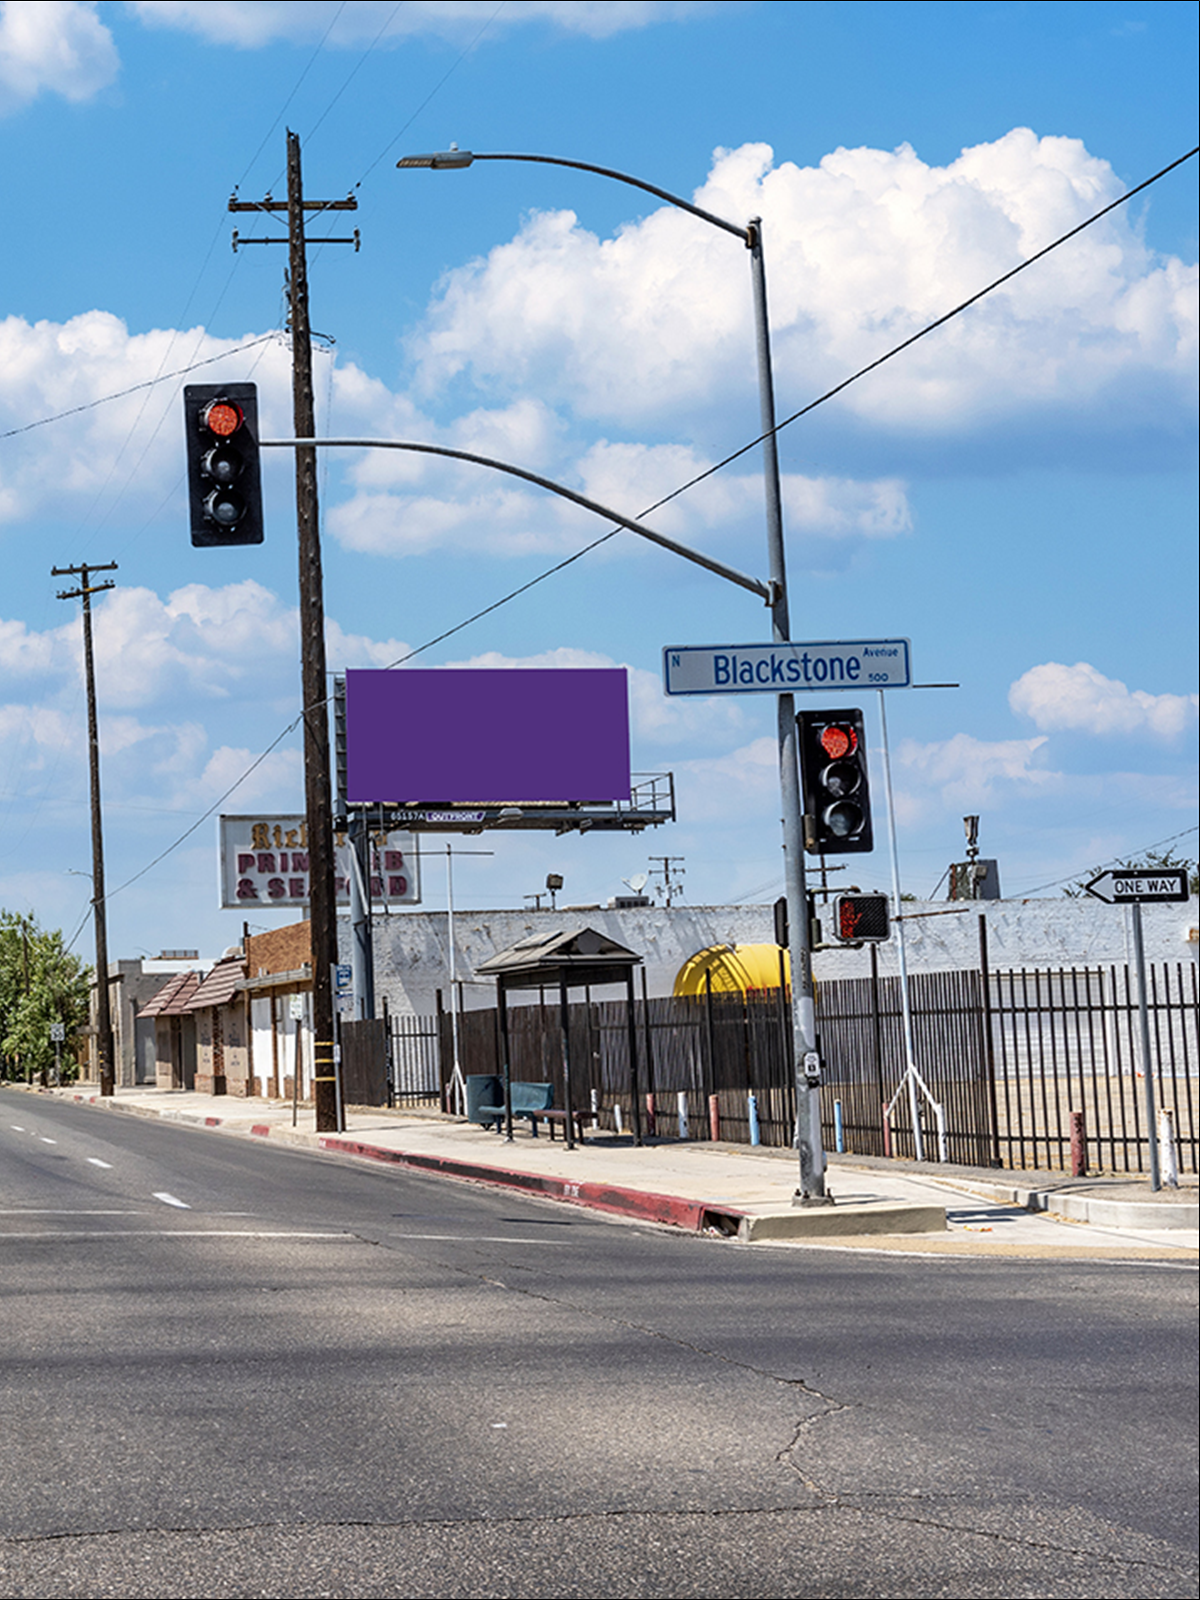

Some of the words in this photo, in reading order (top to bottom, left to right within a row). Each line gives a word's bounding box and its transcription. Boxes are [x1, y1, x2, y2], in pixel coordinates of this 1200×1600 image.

[672, 655, 680, 667] N
[714, 651, 861, 685] Blackstone
[863, 647, 899, 658] Avenue
[868, 672, 889, 682] 500
[238, 851, 337, 873] PRIM
[237, 878, 258, 899] &
[1114, 880, 1143, 893] ONE
[1147, 880, 1176, 892] WAY
